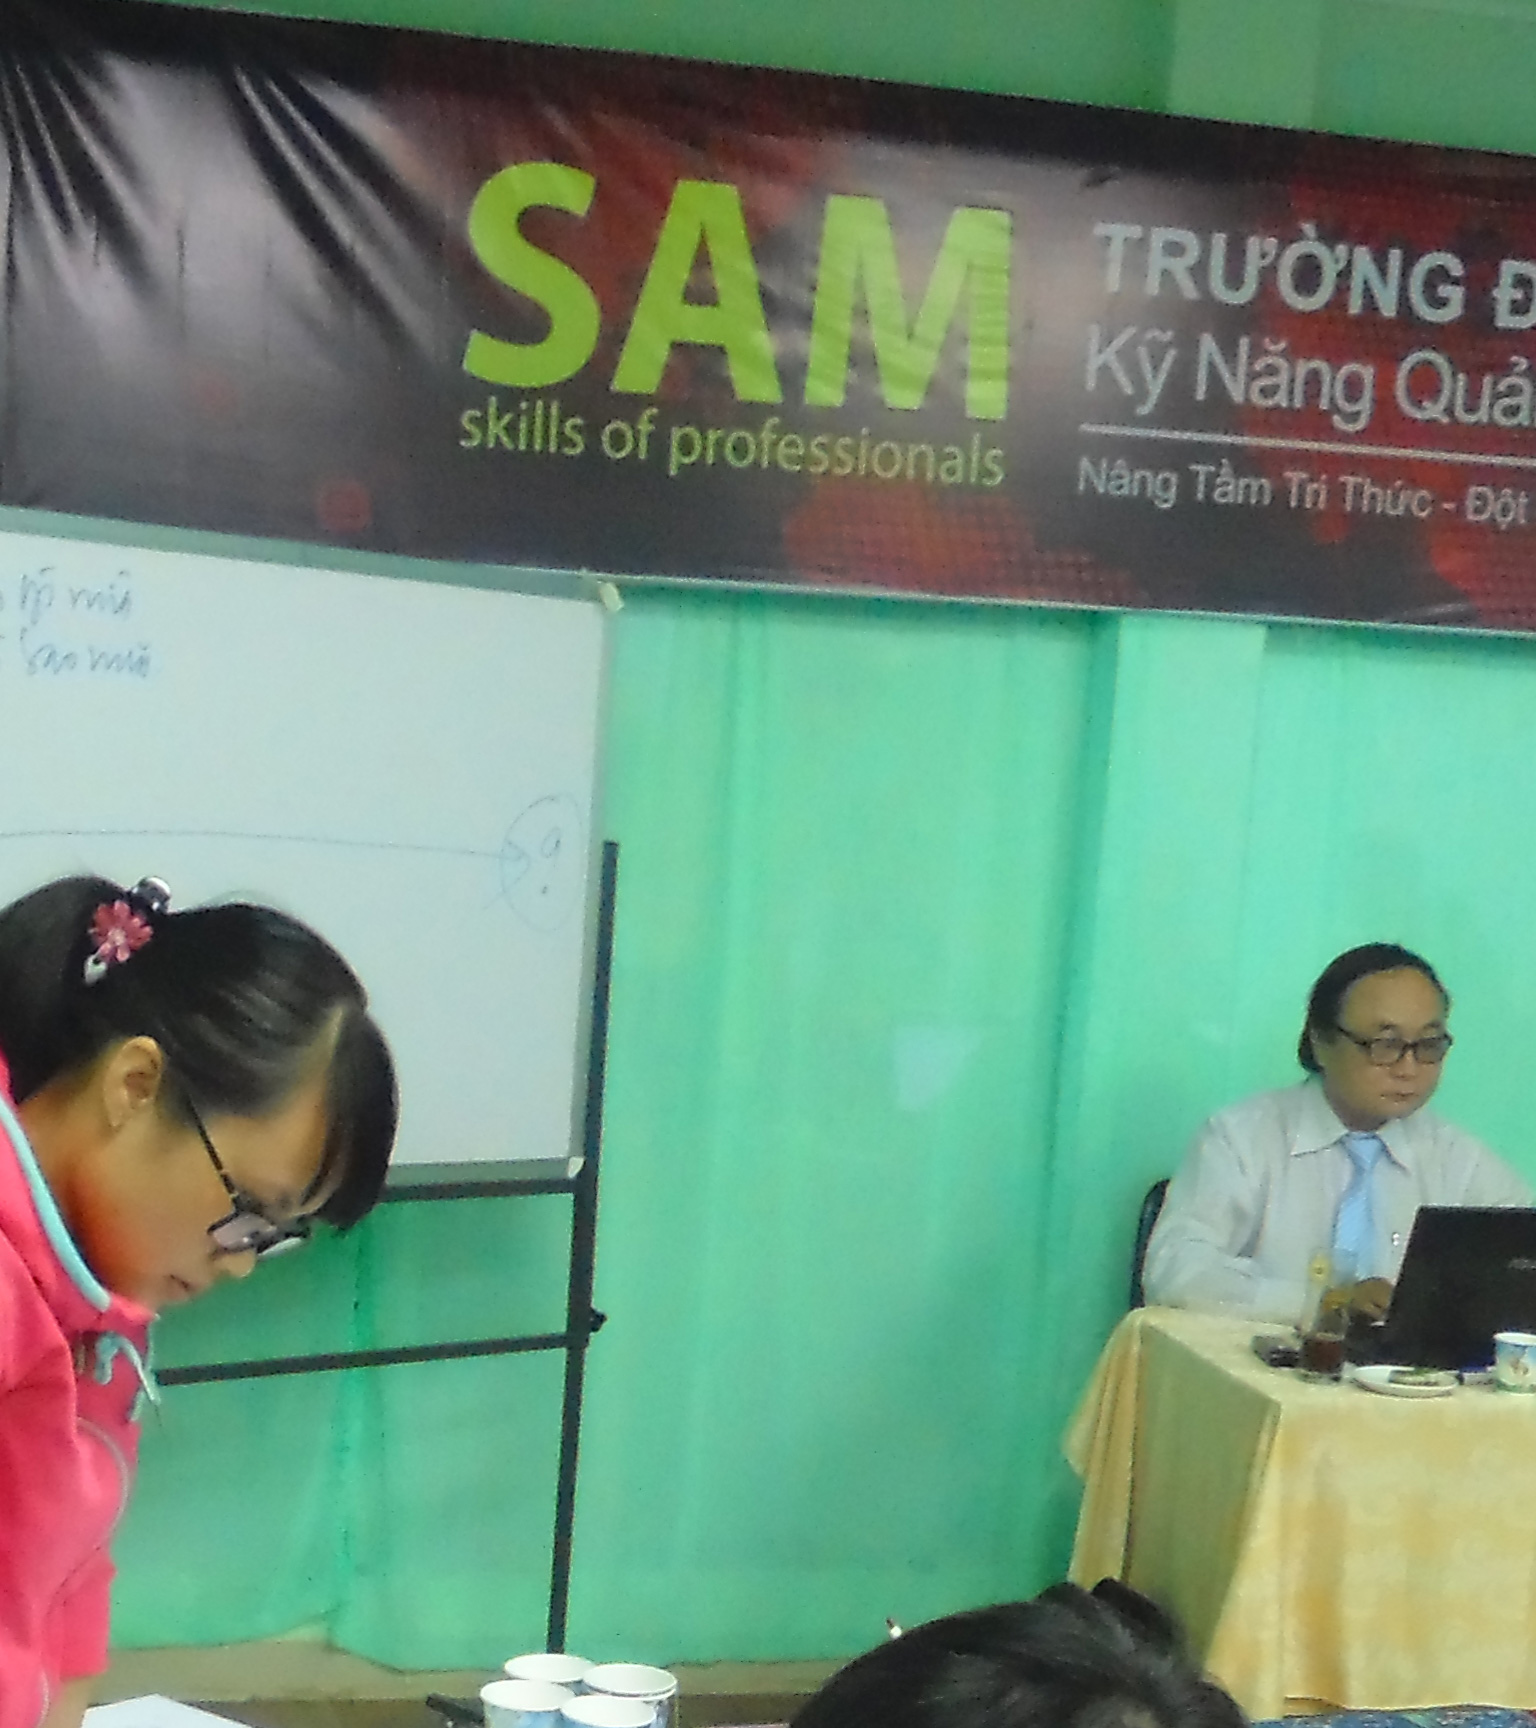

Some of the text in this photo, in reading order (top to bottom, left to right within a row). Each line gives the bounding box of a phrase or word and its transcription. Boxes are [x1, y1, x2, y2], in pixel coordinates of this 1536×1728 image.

[462, 161, 1014, 421] SAM
[1093, 221, 1465, 324] TRƯỜNG
[1085, 324, 1178, 416] Kỹ
[1195, 332, 1376, 433] Năng
[458, 396, 1005, 487] skills of professionals
[1077, 456, 1179, 510] Nâng
[1189, 458, 1272, 505] Tầm
[1338, 474, 1433, 519] Thức
[1466, 484, 1530, 531] Đột
